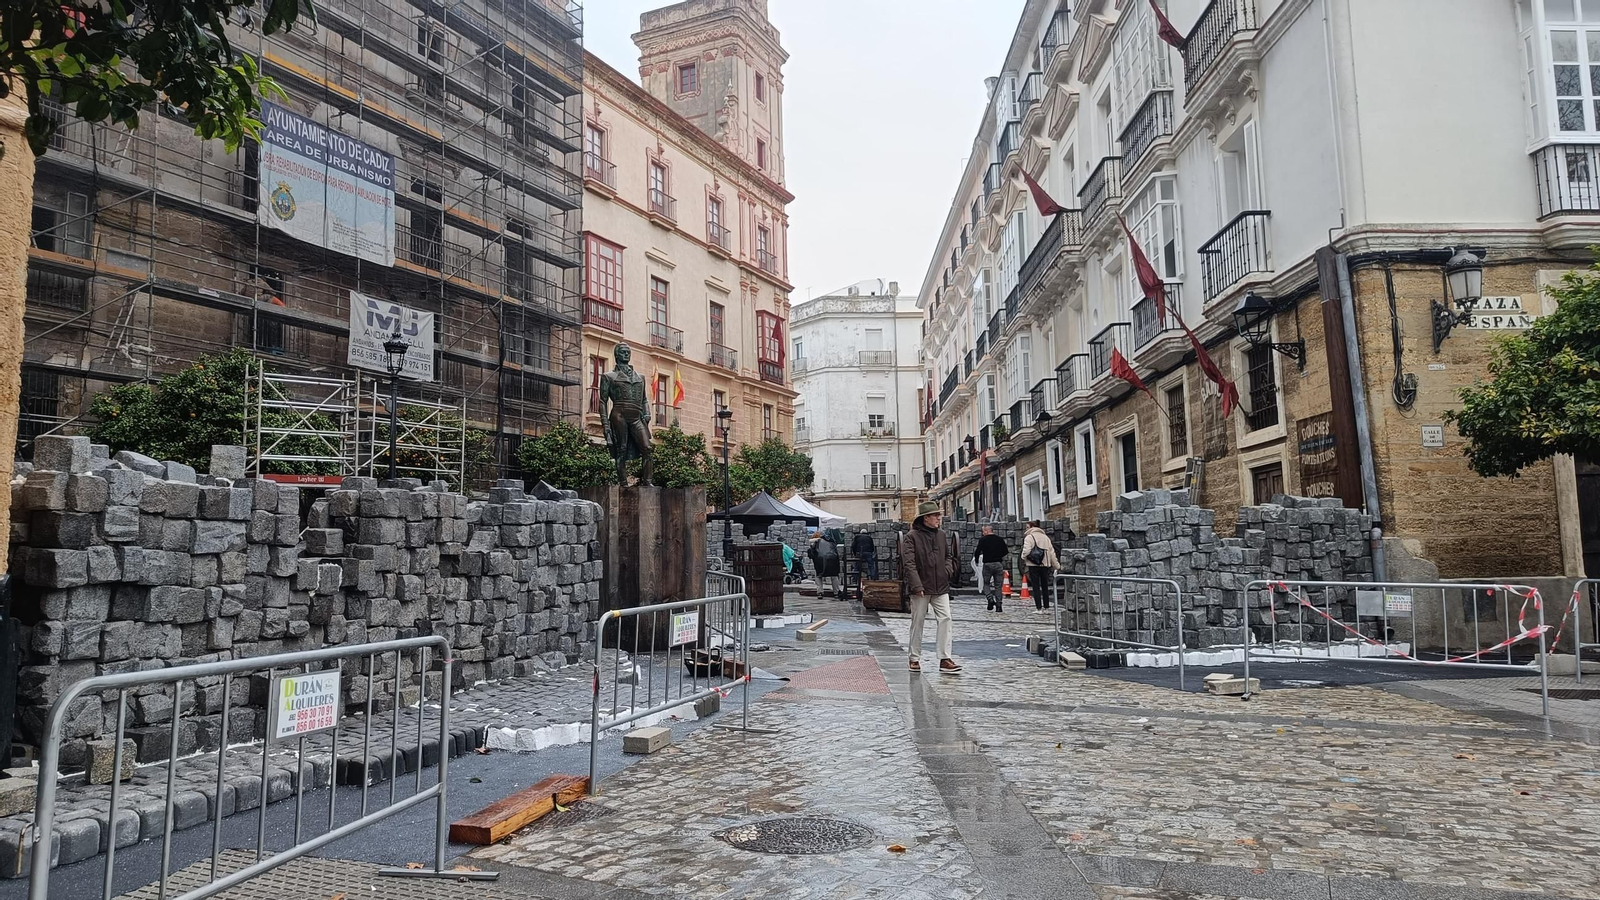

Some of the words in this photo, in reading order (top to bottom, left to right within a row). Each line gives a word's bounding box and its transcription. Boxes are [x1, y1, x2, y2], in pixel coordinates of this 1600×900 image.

[267, 107, 346, 155] AYUNTAMIENTO
[348, 141, 362, 161] DE
[363, 148, 391, 173] CADIZ
[266, 130, 302, 152] AREA
[305, 145, 322, 160] DE
[324, 152, 391, 186] URBANISMO
[1467, 315, 1530, 329] ESPAN
[351, 347, 364, 358] 856
[365, 351, 377, 361] 585
[379, 354, 391, 364] 18
[409, 360, 419, 370] 974
[421, 363, 431, 372] 151
[1301, 421, 1330, 441] DOUCHES
[1306, 481, 1335, 498] DOUCHES
[284, 677, 323, 698] DURÁN
[284, 693, 334, 711] ALQUILERES
[325, 705, 333, 715] 91
